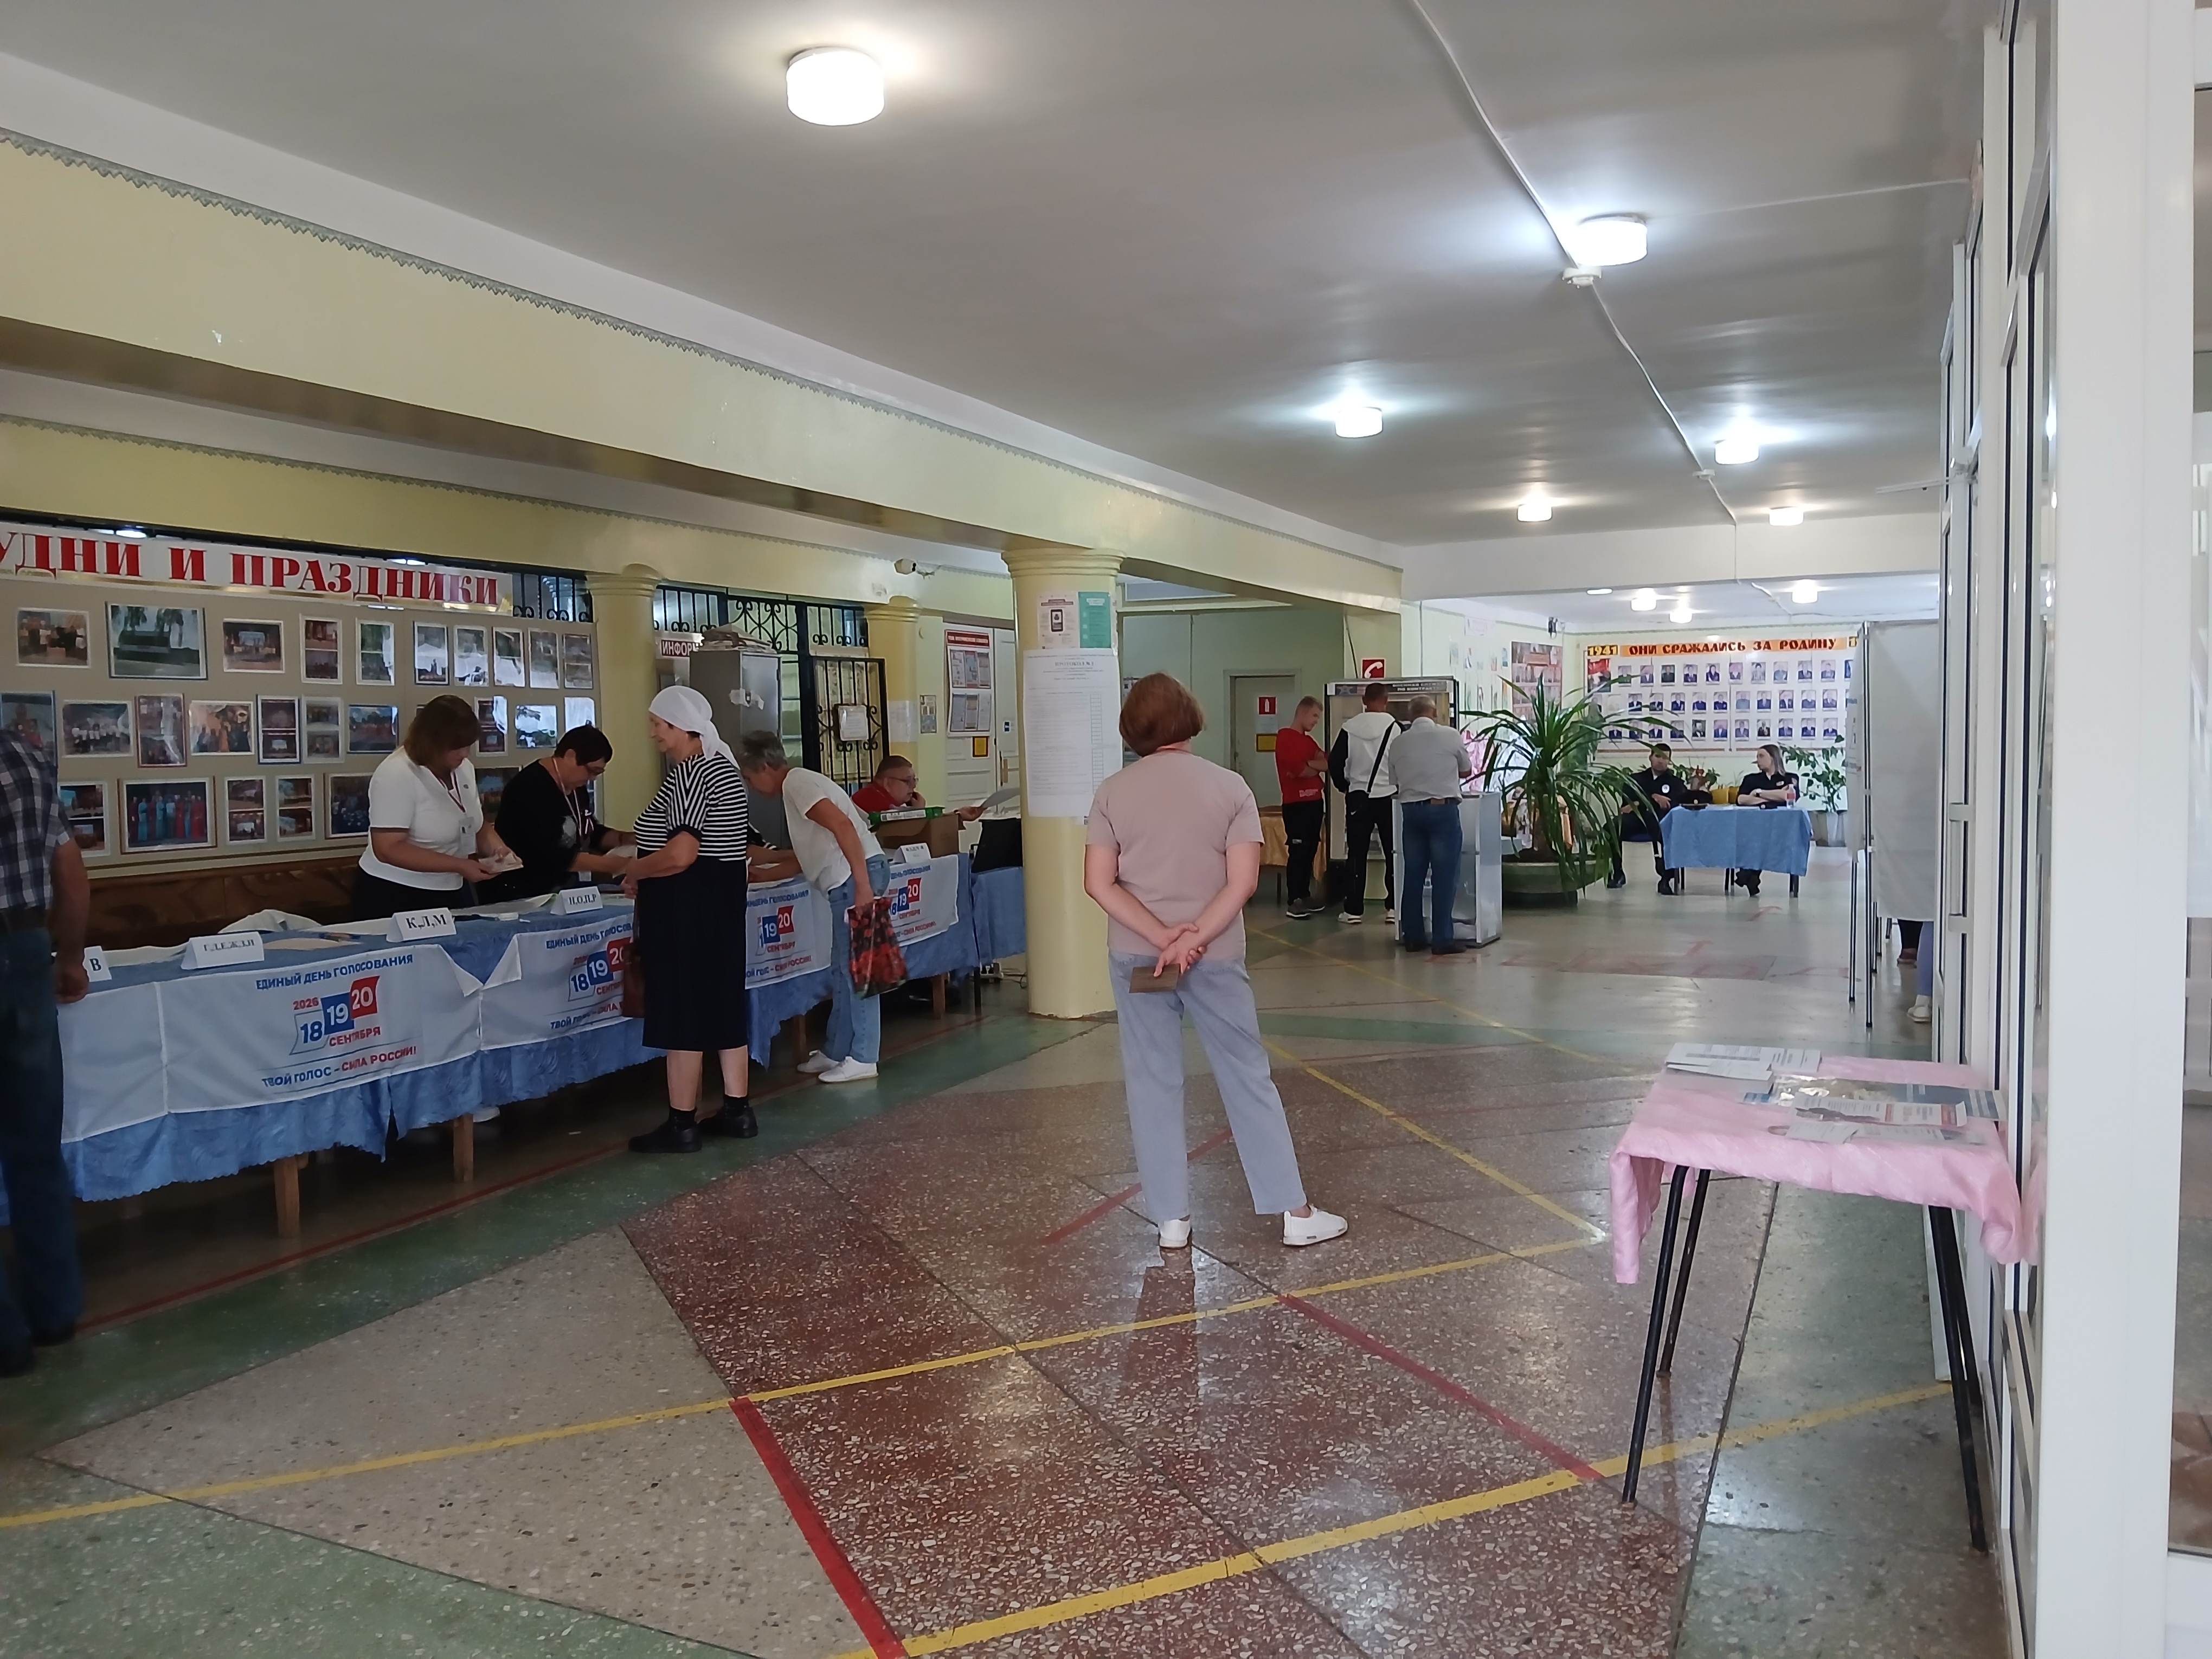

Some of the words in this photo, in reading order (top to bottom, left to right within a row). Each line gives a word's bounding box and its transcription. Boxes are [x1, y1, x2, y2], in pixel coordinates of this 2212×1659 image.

[169, 547, 206, 582] И
[229, 552, 498, 606] ПРАЗДНИКИ
[1588, 646, 1617, 656] 1941
[1629, 645, 1657, 655] ОНИ
[1662, 640, 1746, 654] СРАЖАЛИСЬ
[1753, 641, 1771, 651] ЗА
[1779, 638, 1836, 650] РОДИНУ
[899, 893, 906, 906] 19
[908, 884, 918, 897] 20
[764, 922, 777, 937] 19
[779, 912, 790, 928] 20
[546, 934, 579, 949] ЕДИНЫЙ
[580, 934, 600, 944] ДЕНЬ
[256, 973, 301, 990] ЕДИНЫЙ
[304, 970, 332, 985] ДЕНЬ
[333, 954, 413, 977] ГОЛОСОВАНИЯ
[571, 973, 590, 992] 18
[589, 960, 608, 978] 19
[293, 997, 319, 1010] 2026
[300, 1021, 323, 1044] 18
[326, 1003, 349, 1026] 19
[351, 986, 374, 1010] 20
[550, 1016, 571, 1029] ТВОЙ
[329, 1026, 381, 1047] СЕНТЯБРЯ
[262, 1074, 292, 1088] ТВОЙ
[294, 1066, 332, 1082] ГОЛОС
[342, 1057, 368, 1071] СИЛА
[370, 1046, 416, 1064] РОССИИ!
